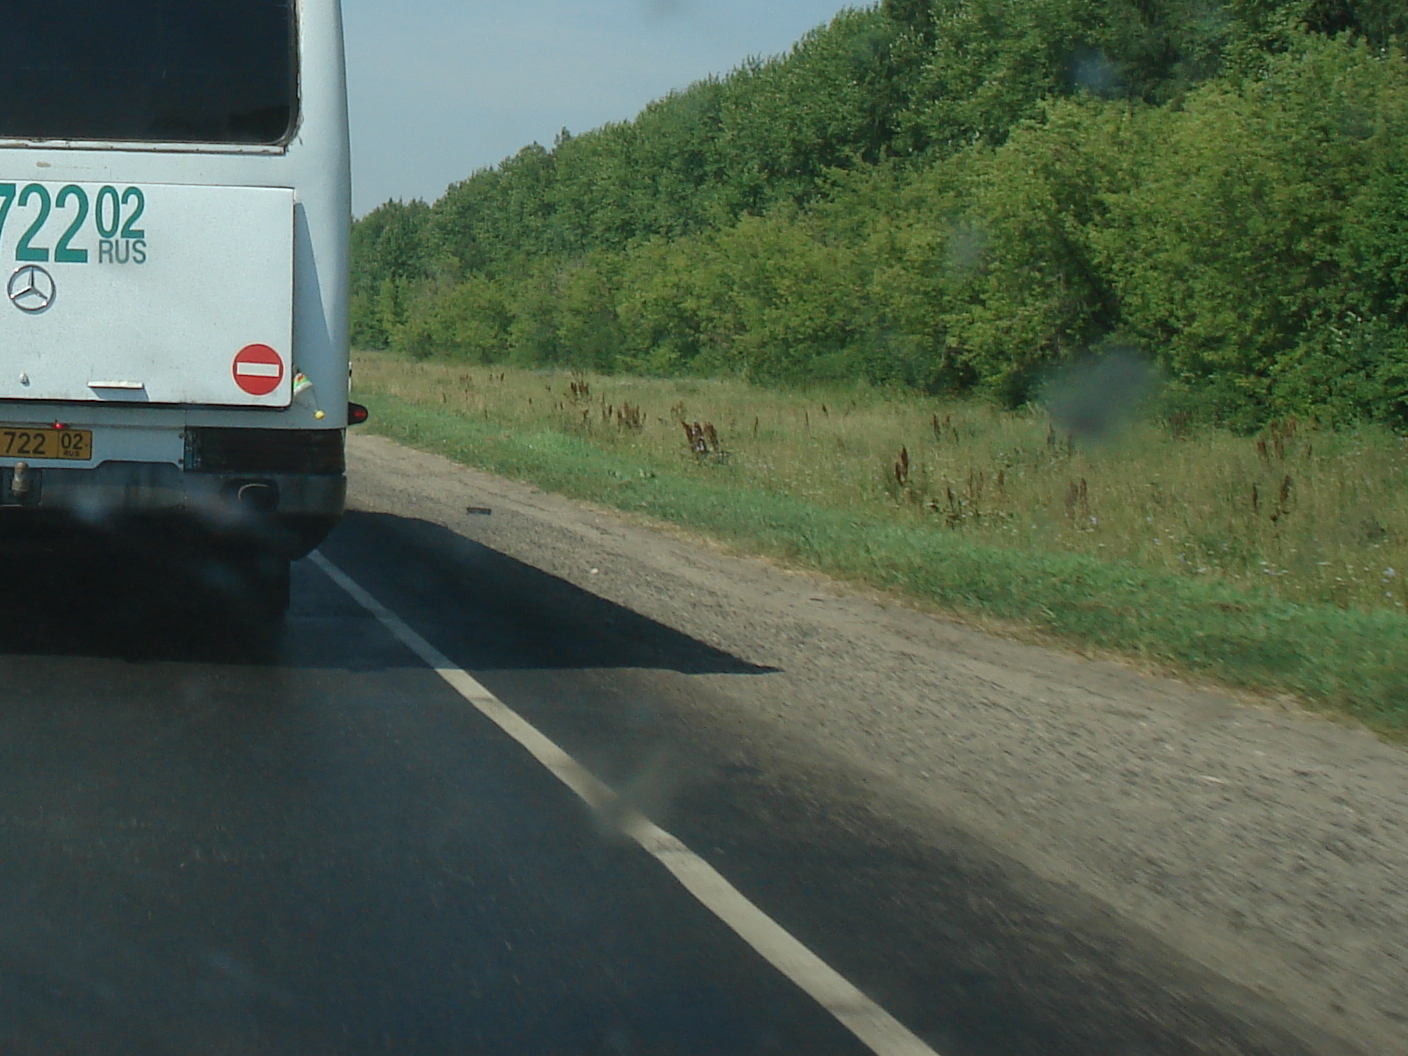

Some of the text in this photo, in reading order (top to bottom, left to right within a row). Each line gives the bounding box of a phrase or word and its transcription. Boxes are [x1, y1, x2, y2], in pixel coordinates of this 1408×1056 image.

[95, 185, 145, 239] 02
[98, 239, 147, 264] RUS
[4, 432, 46, 455] 722
[61, 433, 83, 450] 02
